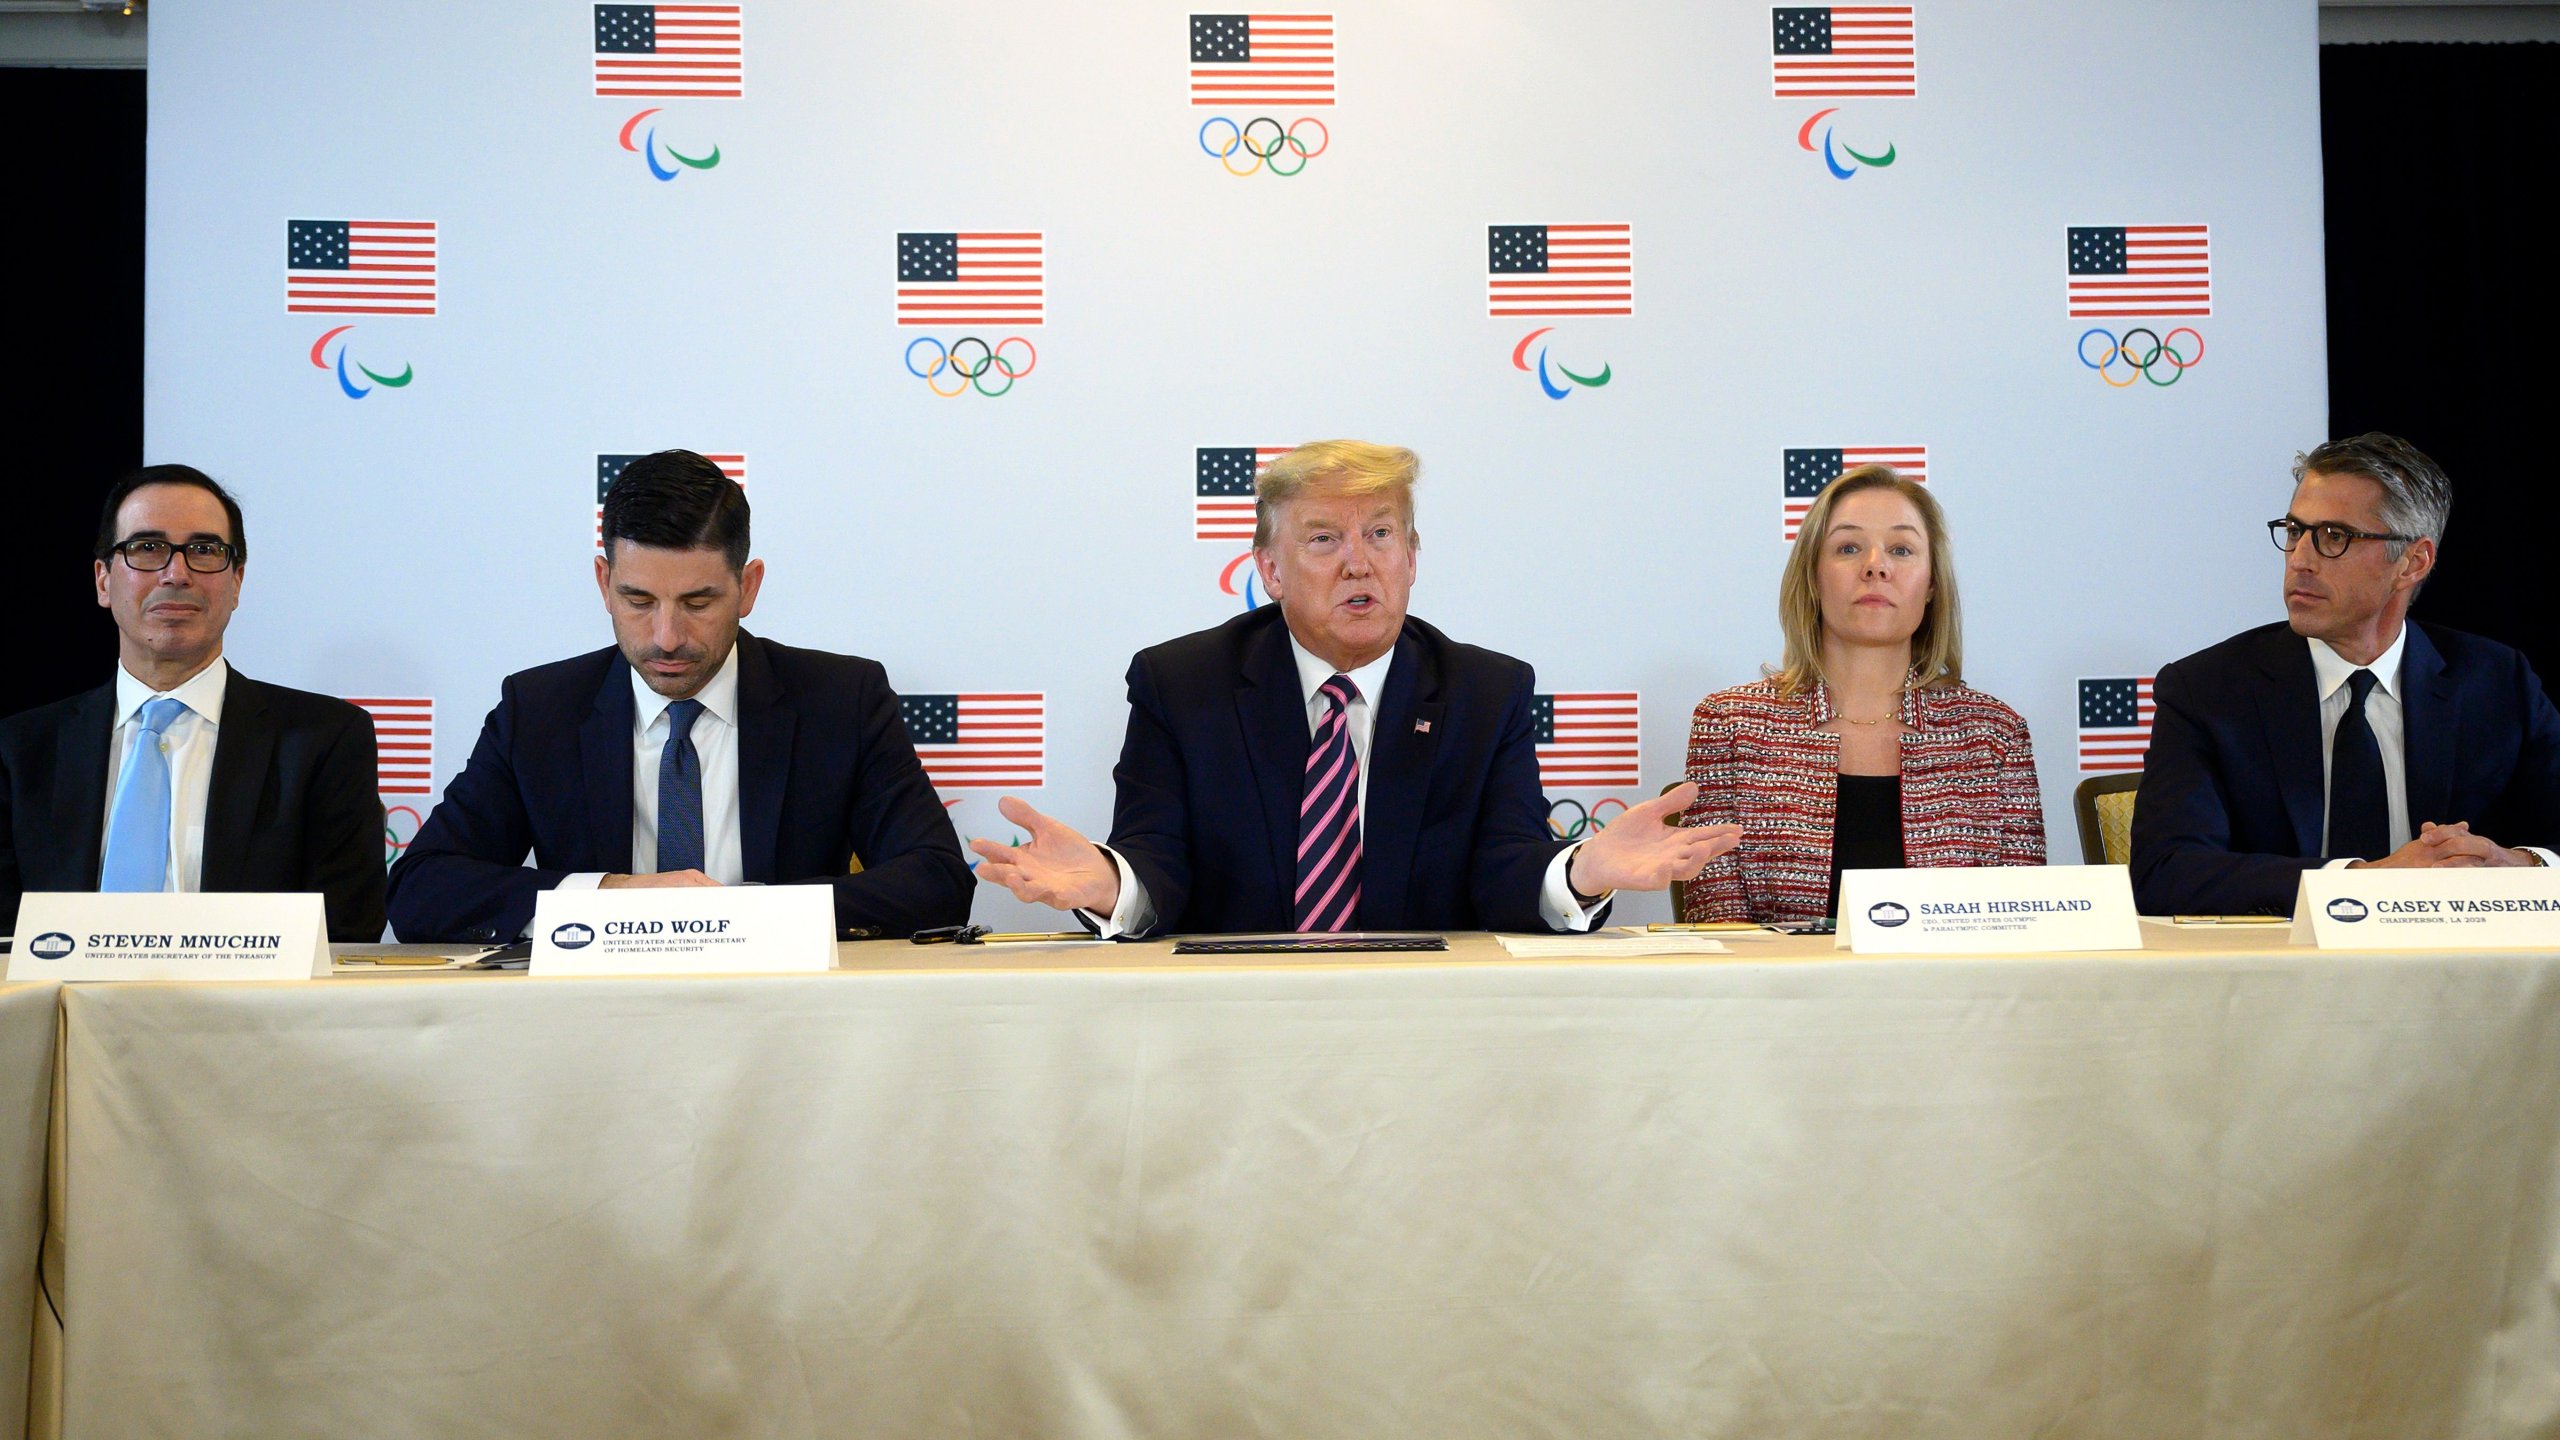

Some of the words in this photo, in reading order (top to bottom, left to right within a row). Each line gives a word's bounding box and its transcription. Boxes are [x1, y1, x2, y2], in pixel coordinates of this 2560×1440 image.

[1920, 903, 1981, 914] SARAH
[1987, 900, 2092, 913] HIRSHLAND
[2376, 901, 2441, 913] CASEY
[604, 921, 663, 934] CHAD
[671, 920, 730, 933] WOLF
[88, 934, 172, 948] STEVEN
[180, 935, 281, 948] MNUCHIN
